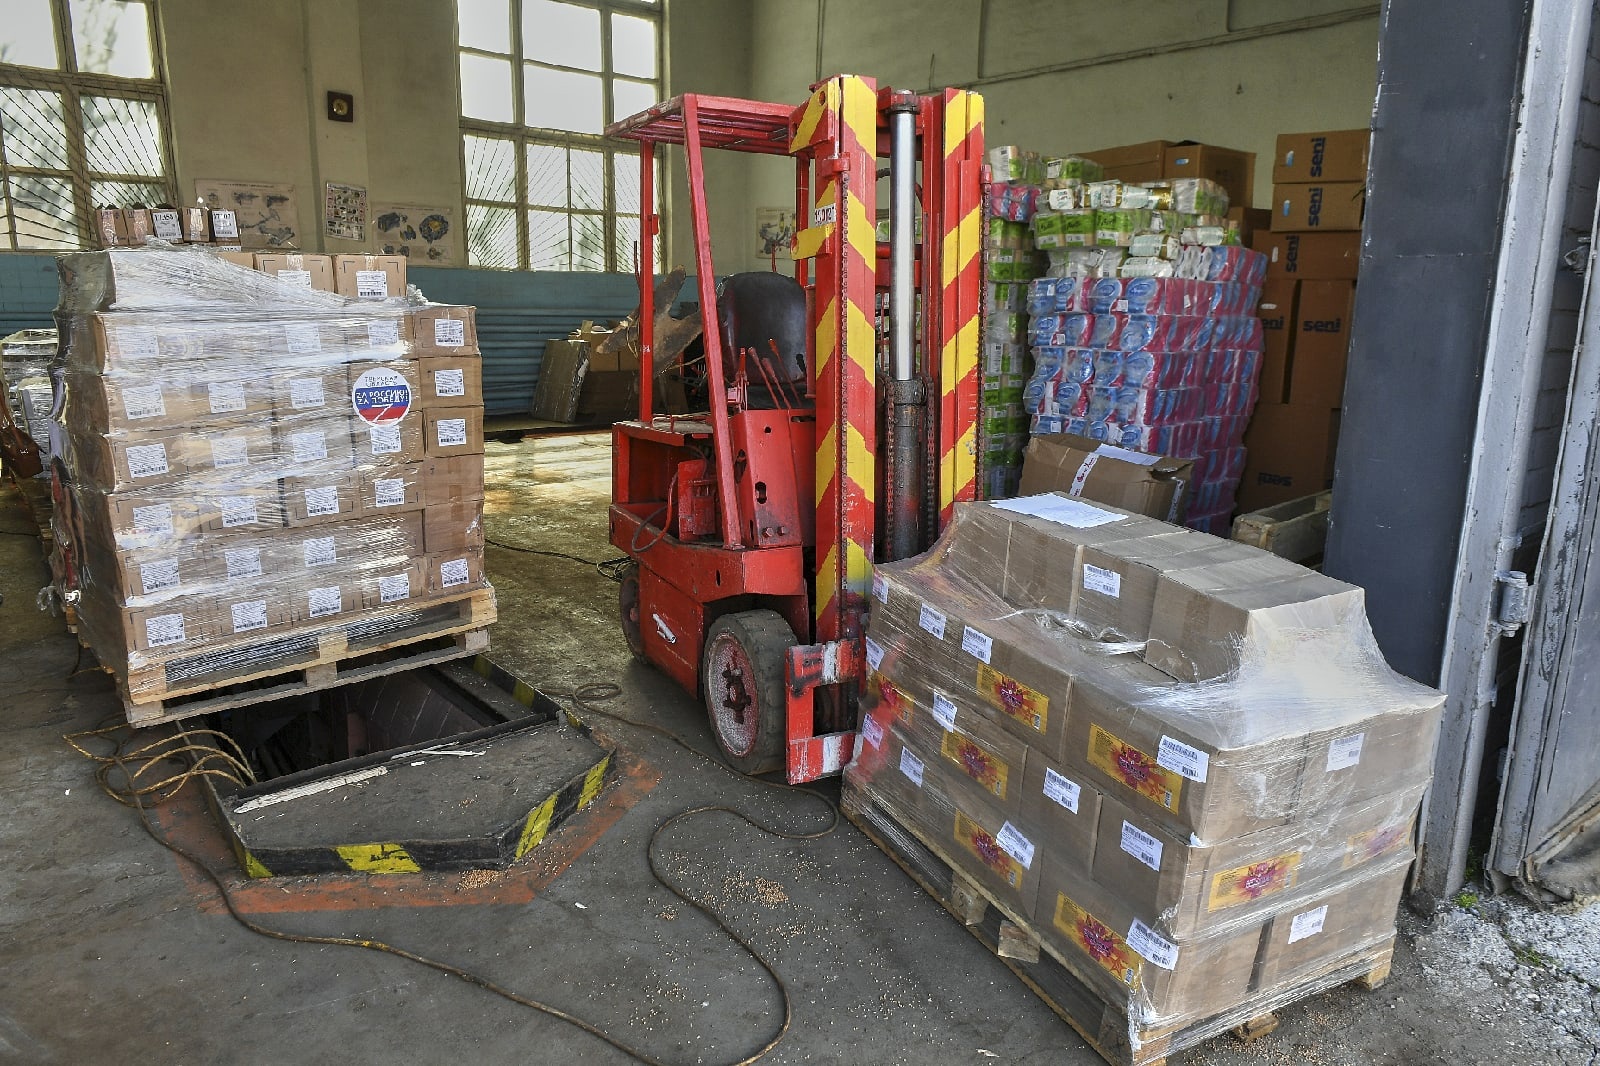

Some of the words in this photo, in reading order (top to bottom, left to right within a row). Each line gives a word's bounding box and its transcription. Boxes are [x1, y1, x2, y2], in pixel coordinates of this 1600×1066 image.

[1310, 137, 1326, 177] seni
[1308, 187, 1323, 227] seni
[1285, 235, 1300, 272] seni
[1262, 315, 1284, 330] eni
[1303, 318, 1341, 333] seni
